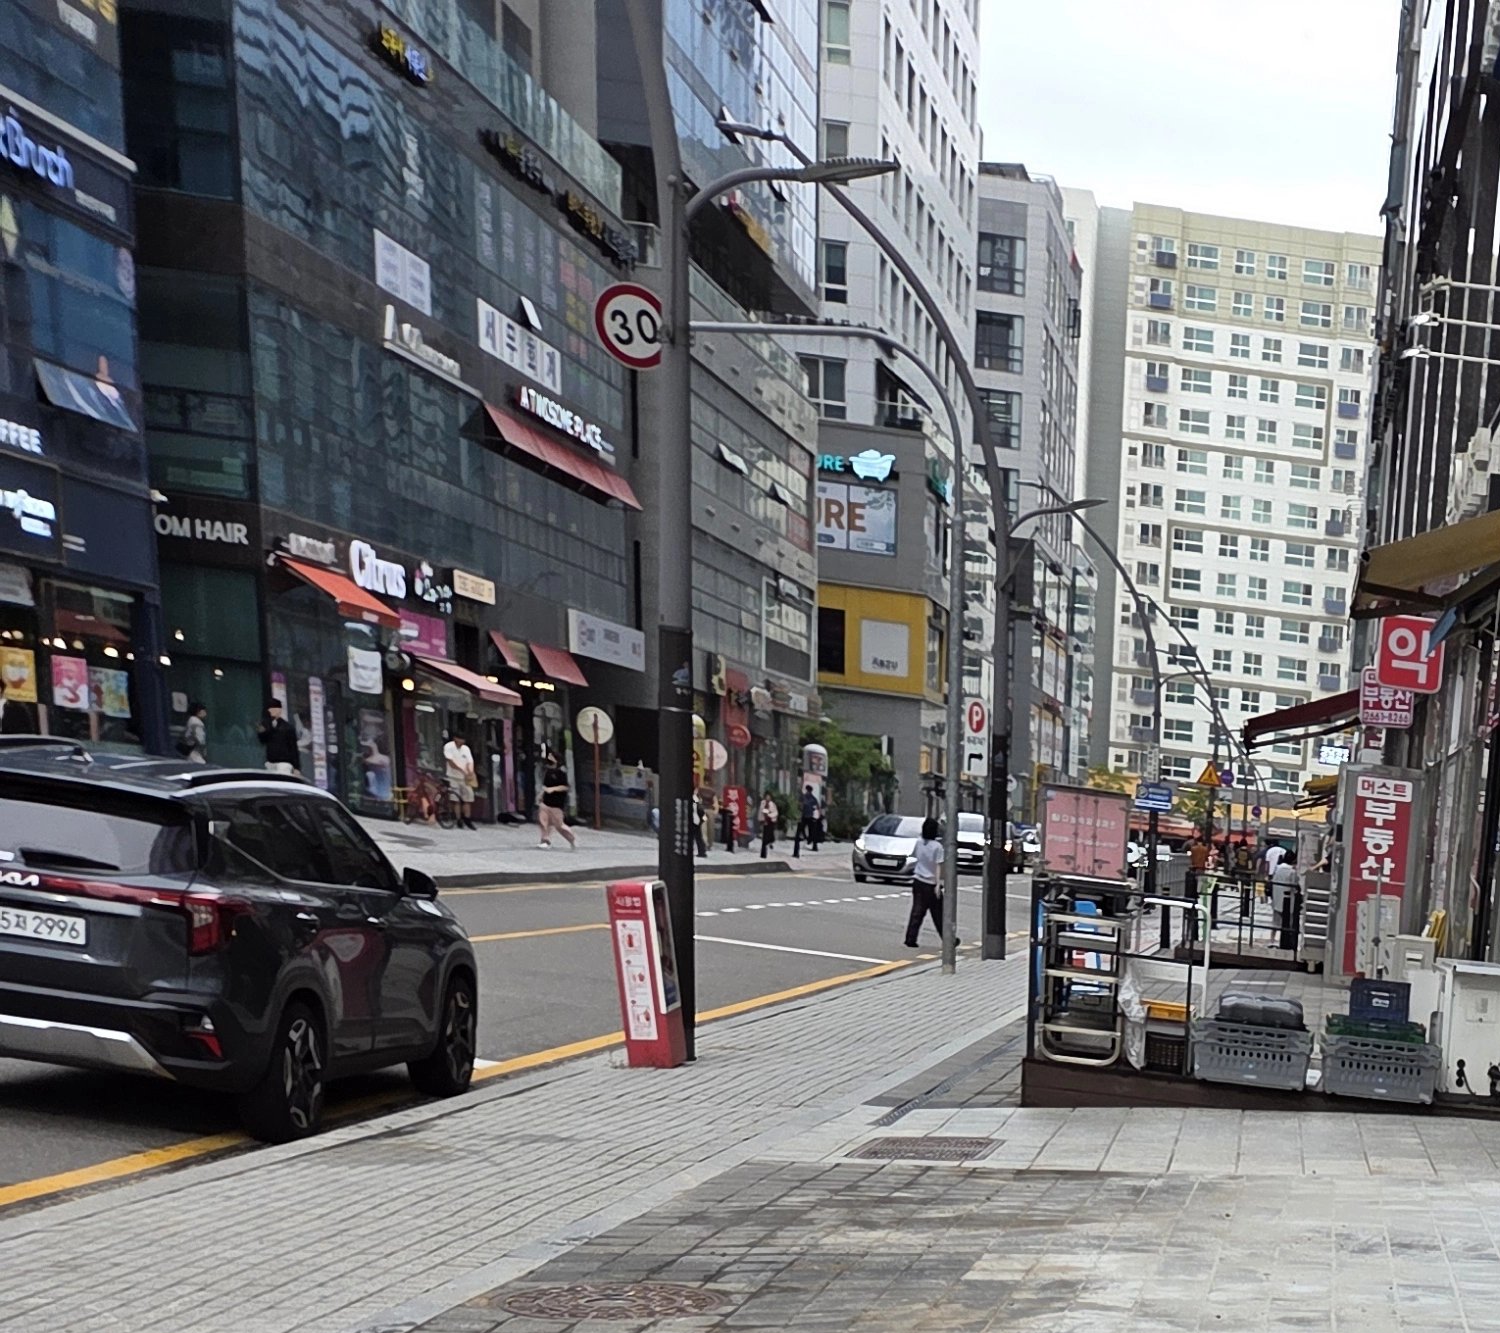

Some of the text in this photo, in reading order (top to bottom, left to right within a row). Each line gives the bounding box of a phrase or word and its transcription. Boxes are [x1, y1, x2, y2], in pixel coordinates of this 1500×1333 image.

[610, 309, 662, 346] 30
[195, 518, 249, 545] HAIR
[1388, 627, 1436, 685] 약
[1360, 779, 1407, 798] 머스트
[1358, 799, 1397, 883] 부동산
[32, 915, 80, 940] 2996
